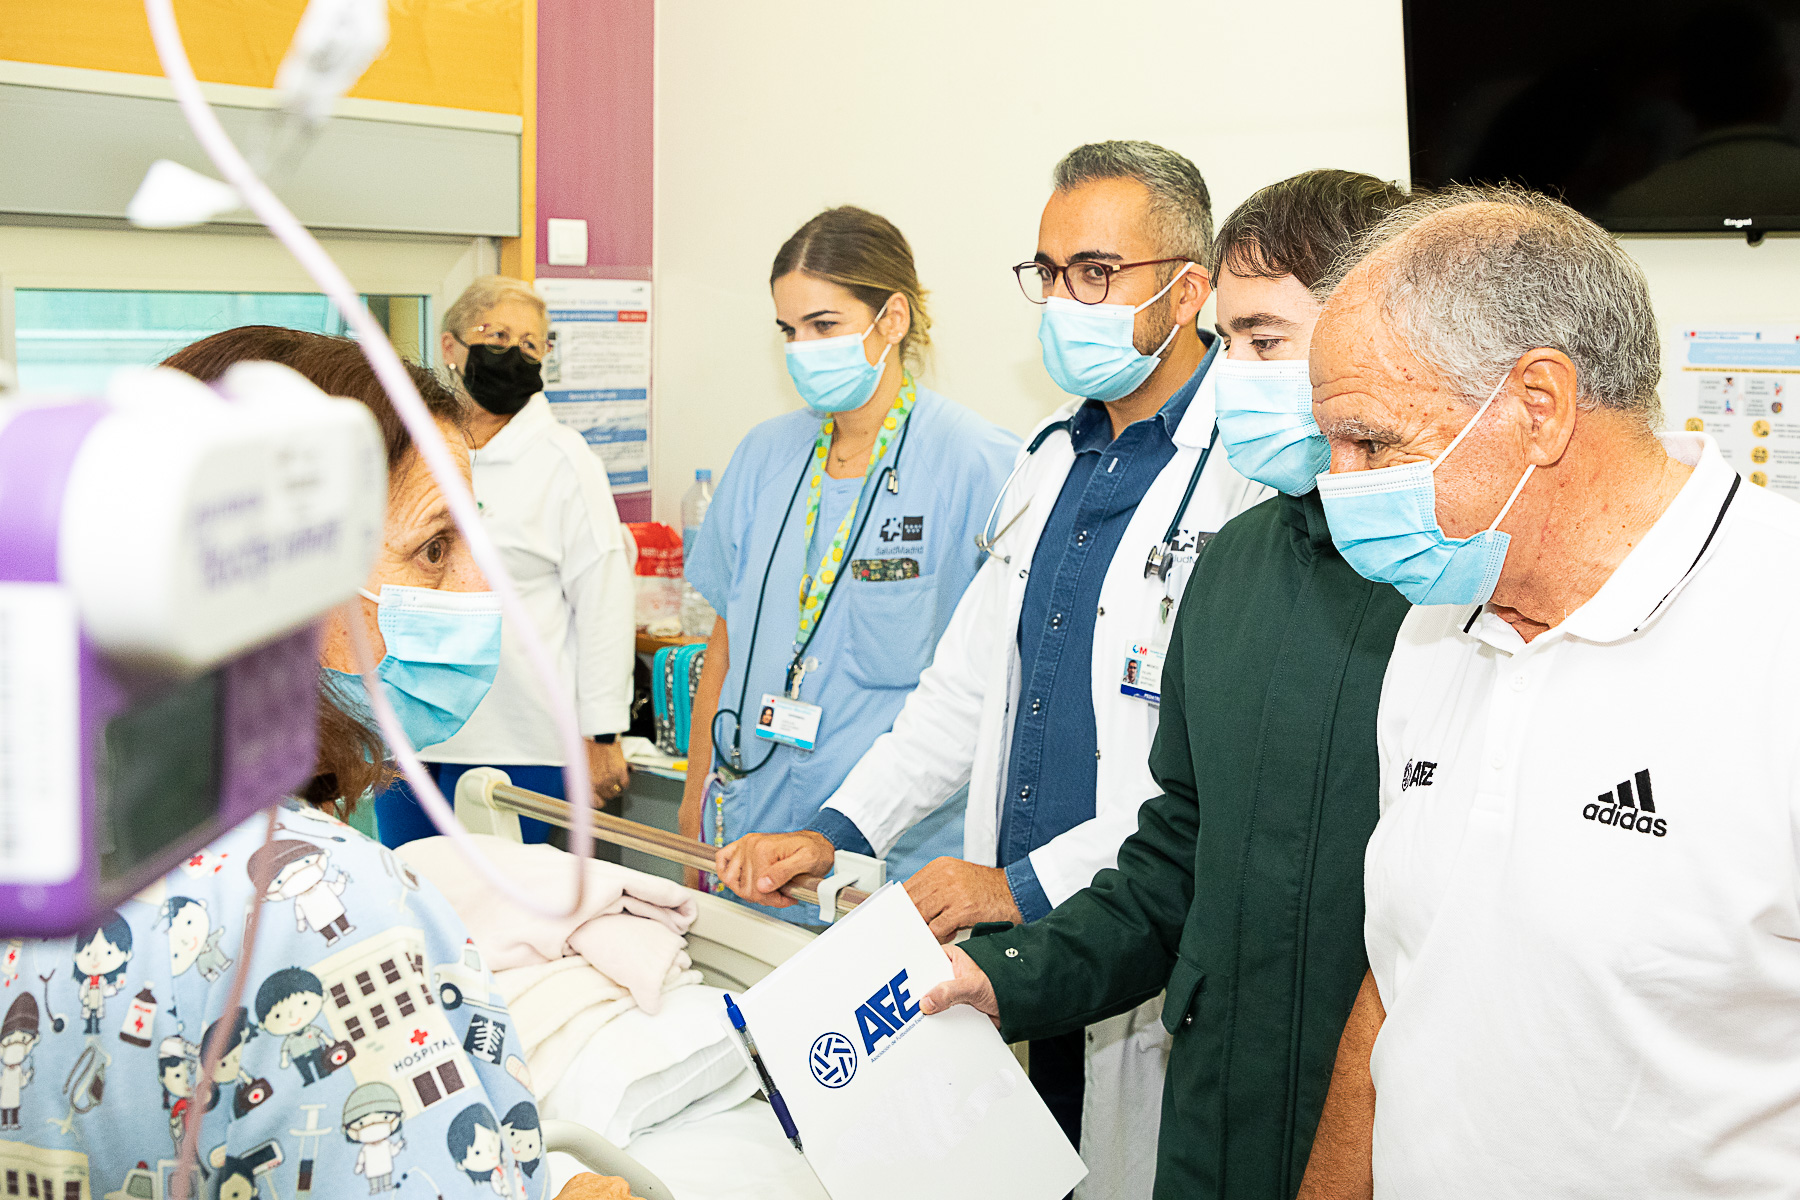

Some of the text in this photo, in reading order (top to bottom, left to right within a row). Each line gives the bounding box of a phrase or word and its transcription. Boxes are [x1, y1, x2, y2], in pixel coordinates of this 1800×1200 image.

[876, 546, 924, 556] SaludMadrid
[1409, 761, 1437, 787] AFE
[1583, 803, 1667, 837] adidas
[854, 967, 920, 1056] AFE
[394, 1037, 455, 1072] HOSPITAL
